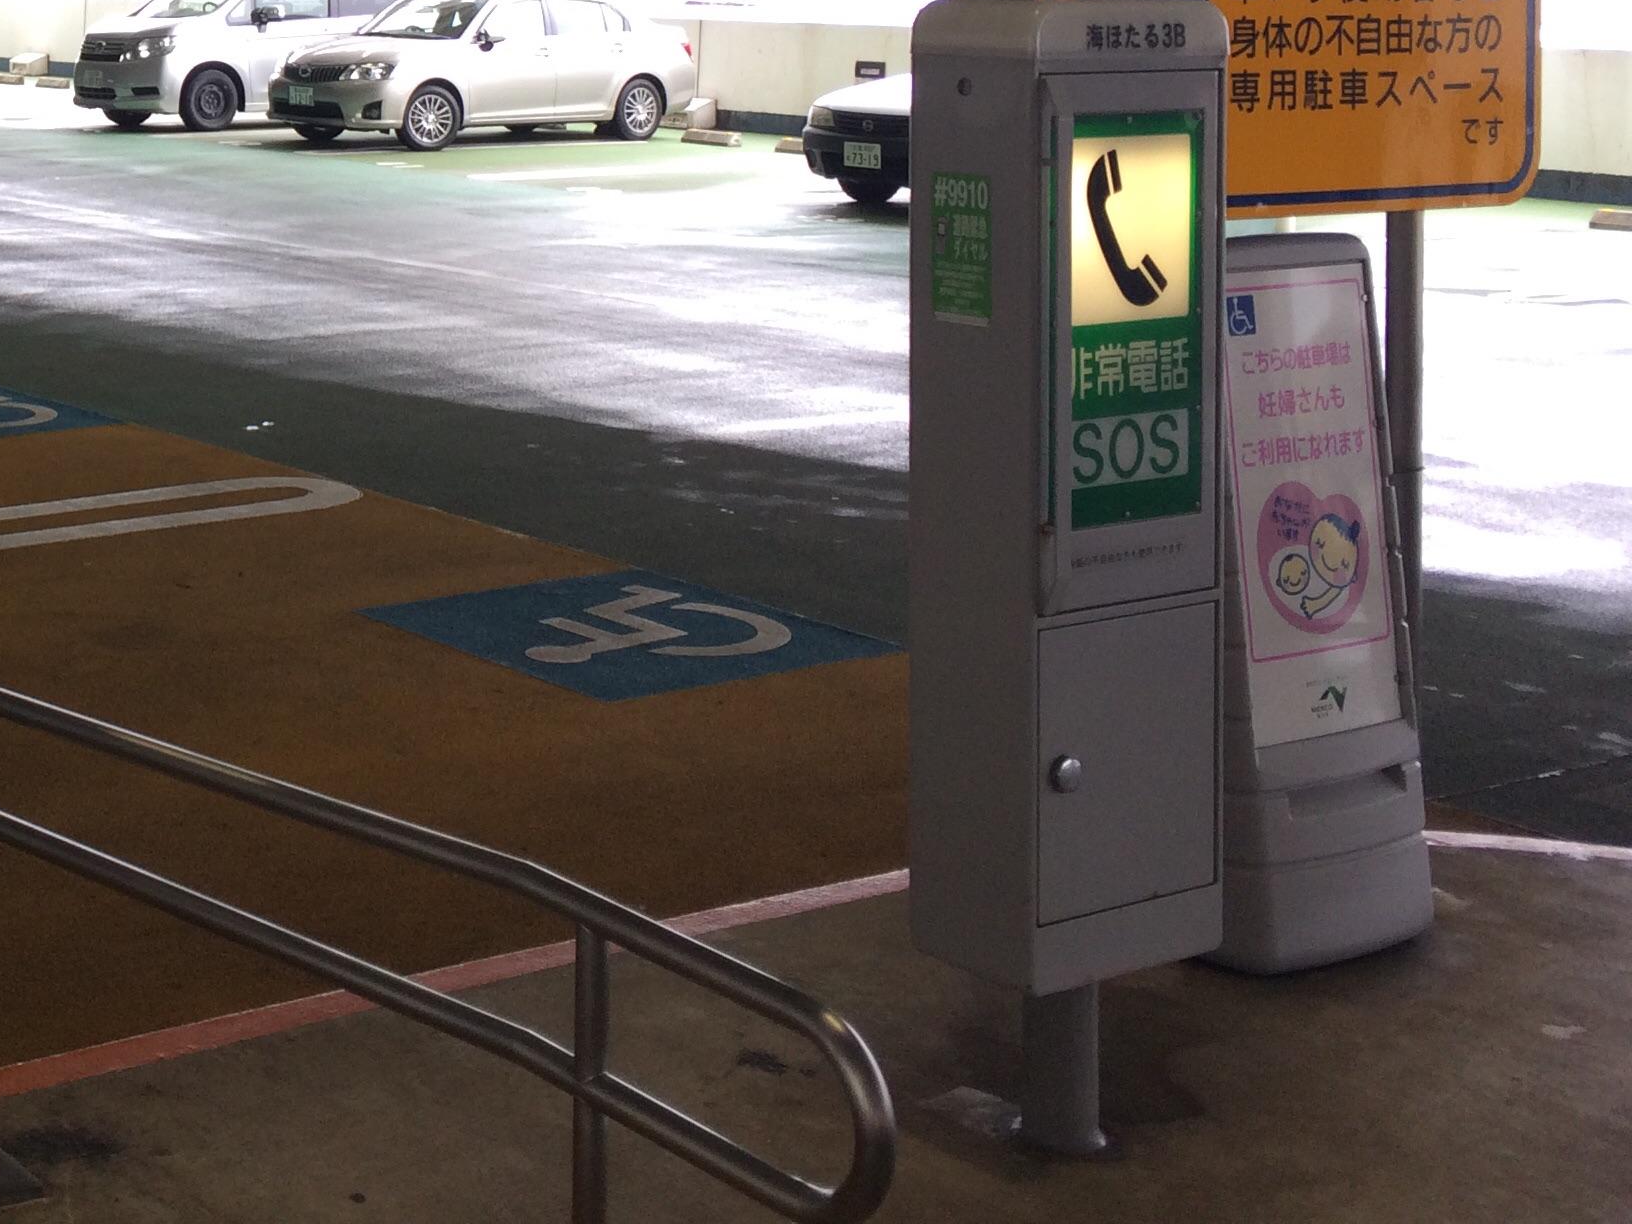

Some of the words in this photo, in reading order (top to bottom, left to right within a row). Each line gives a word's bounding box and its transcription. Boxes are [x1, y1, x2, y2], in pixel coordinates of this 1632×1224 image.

[1229, 12, 1503, 59] 身体の不自由な方の
[1229, 67, 1504, 114] 専用駐車スペース
[1461, 116, 1505, 146] です
[934, 176, 989, 211] #9910
[1241, 340, 1352, 375] こちらの駐車場は
[1257, 384, 1346, 420] 妊婦さんも
[1072, 413, 1181, 485] SOS
[1241, 427, 1366, 468] ご利用になれます
